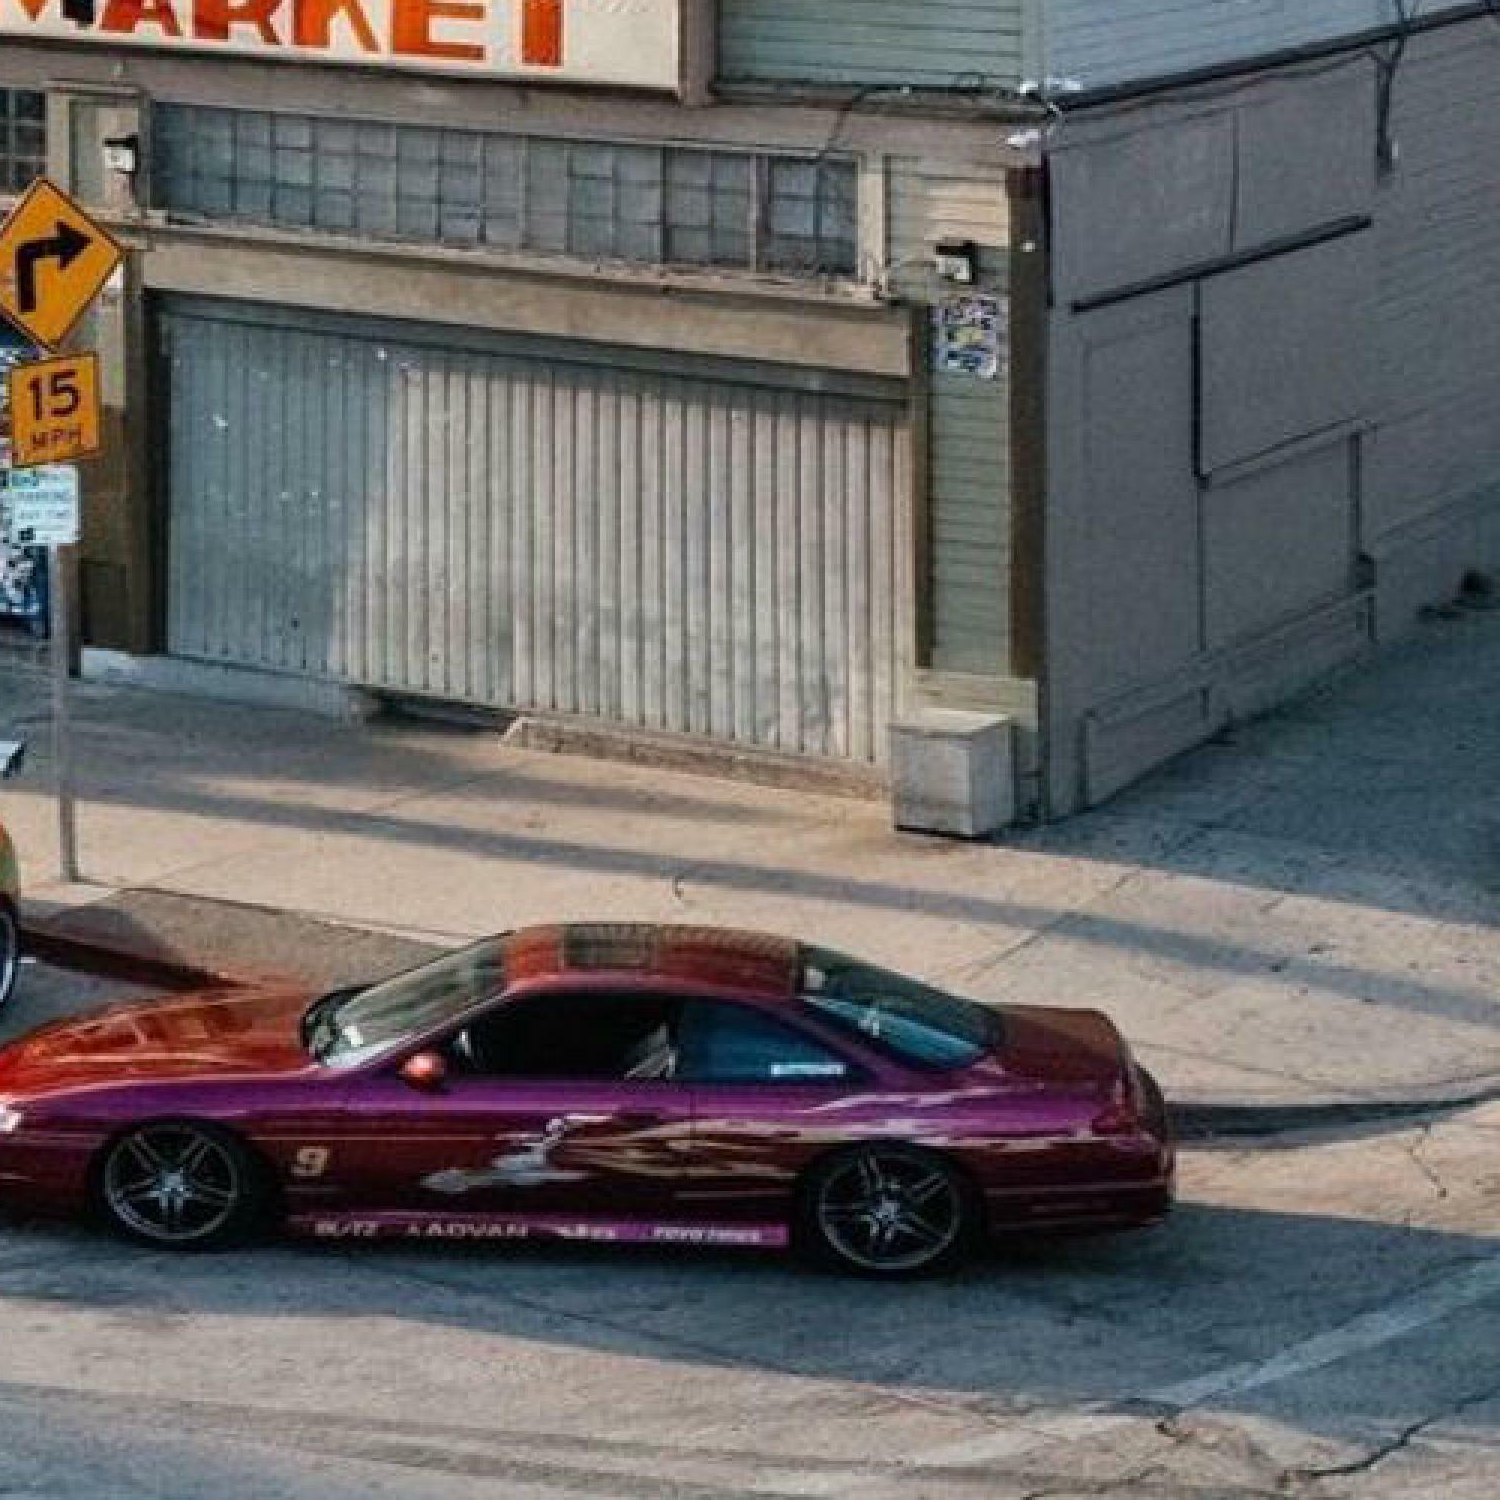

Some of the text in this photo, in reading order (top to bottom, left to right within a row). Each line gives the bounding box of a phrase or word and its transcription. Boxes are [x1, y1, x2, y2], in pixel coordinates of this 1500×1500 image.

[27, 368, 81, 421] 15
[30, 424, 82, 450] MPH
[291, 1146, 329, 1177] 9
[425, 1222, 529, 1238] ADVAN
